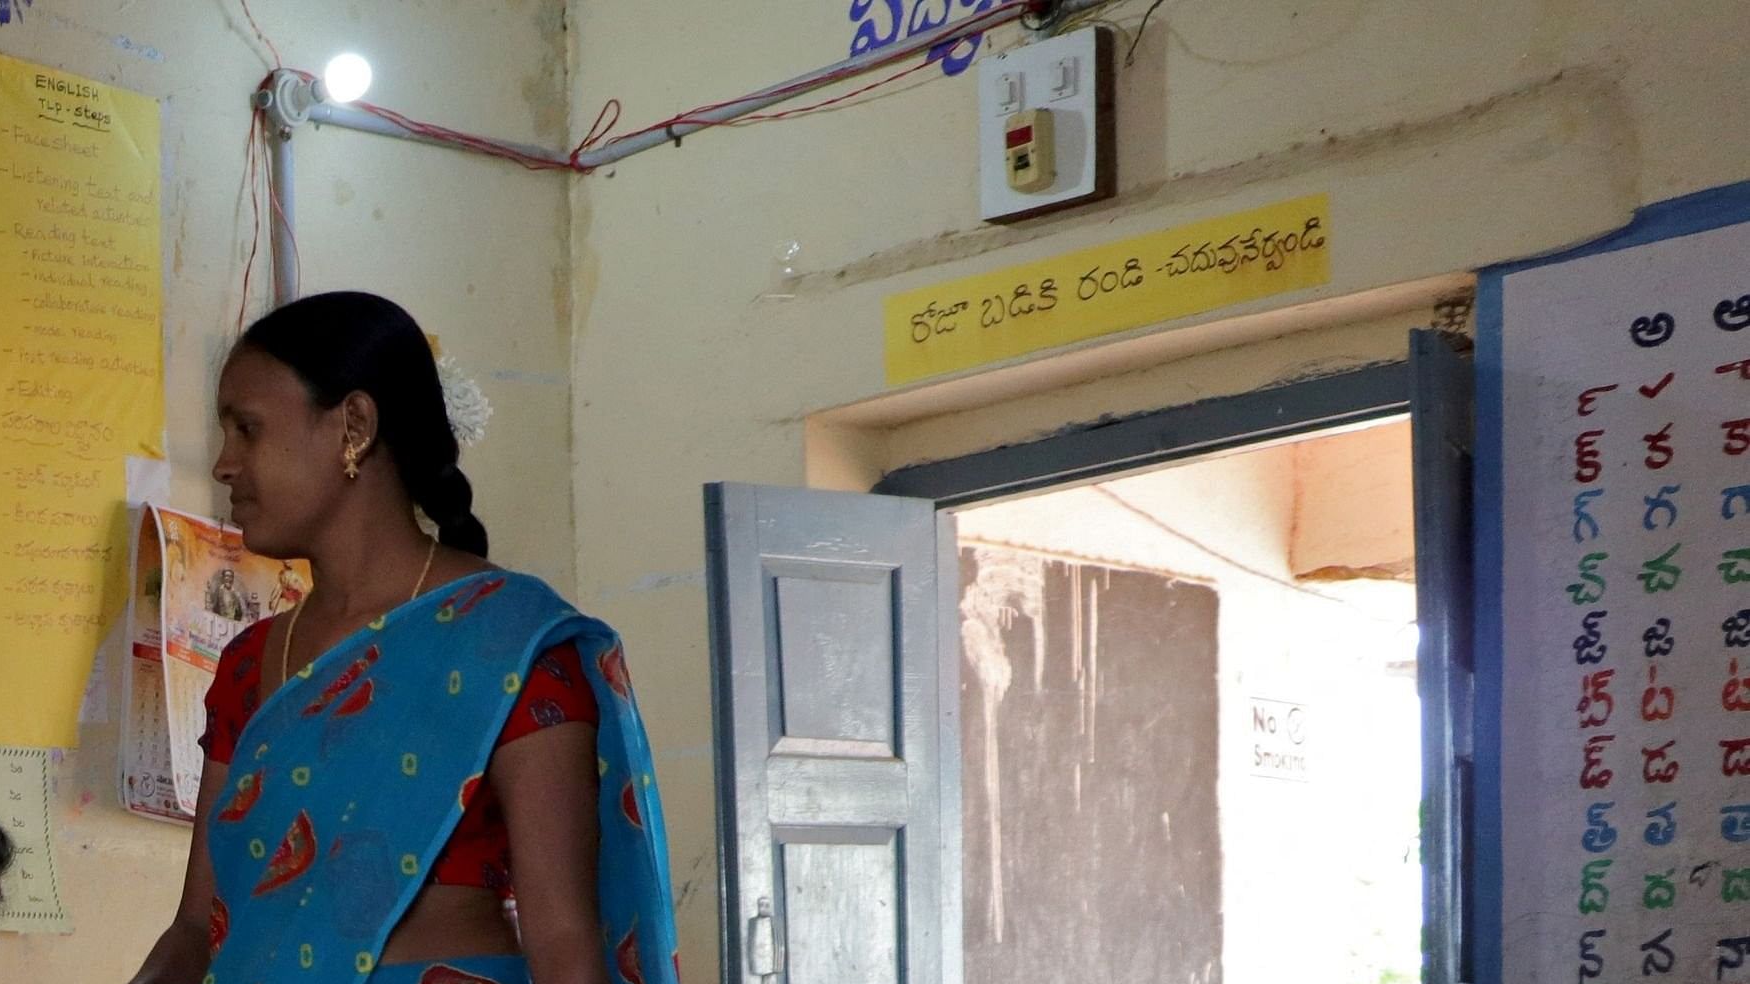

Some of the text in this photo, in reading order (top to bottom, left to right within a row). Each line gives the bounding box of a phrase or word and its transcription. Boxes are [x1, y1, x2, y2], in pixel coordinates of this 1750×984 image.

[35, 74, 99, 102] ENGLISH
[979, 277, 1059, 330] బడికి
[1076, 255, 1145, 302] రండి
[1252, 706, 1278, 735] No
